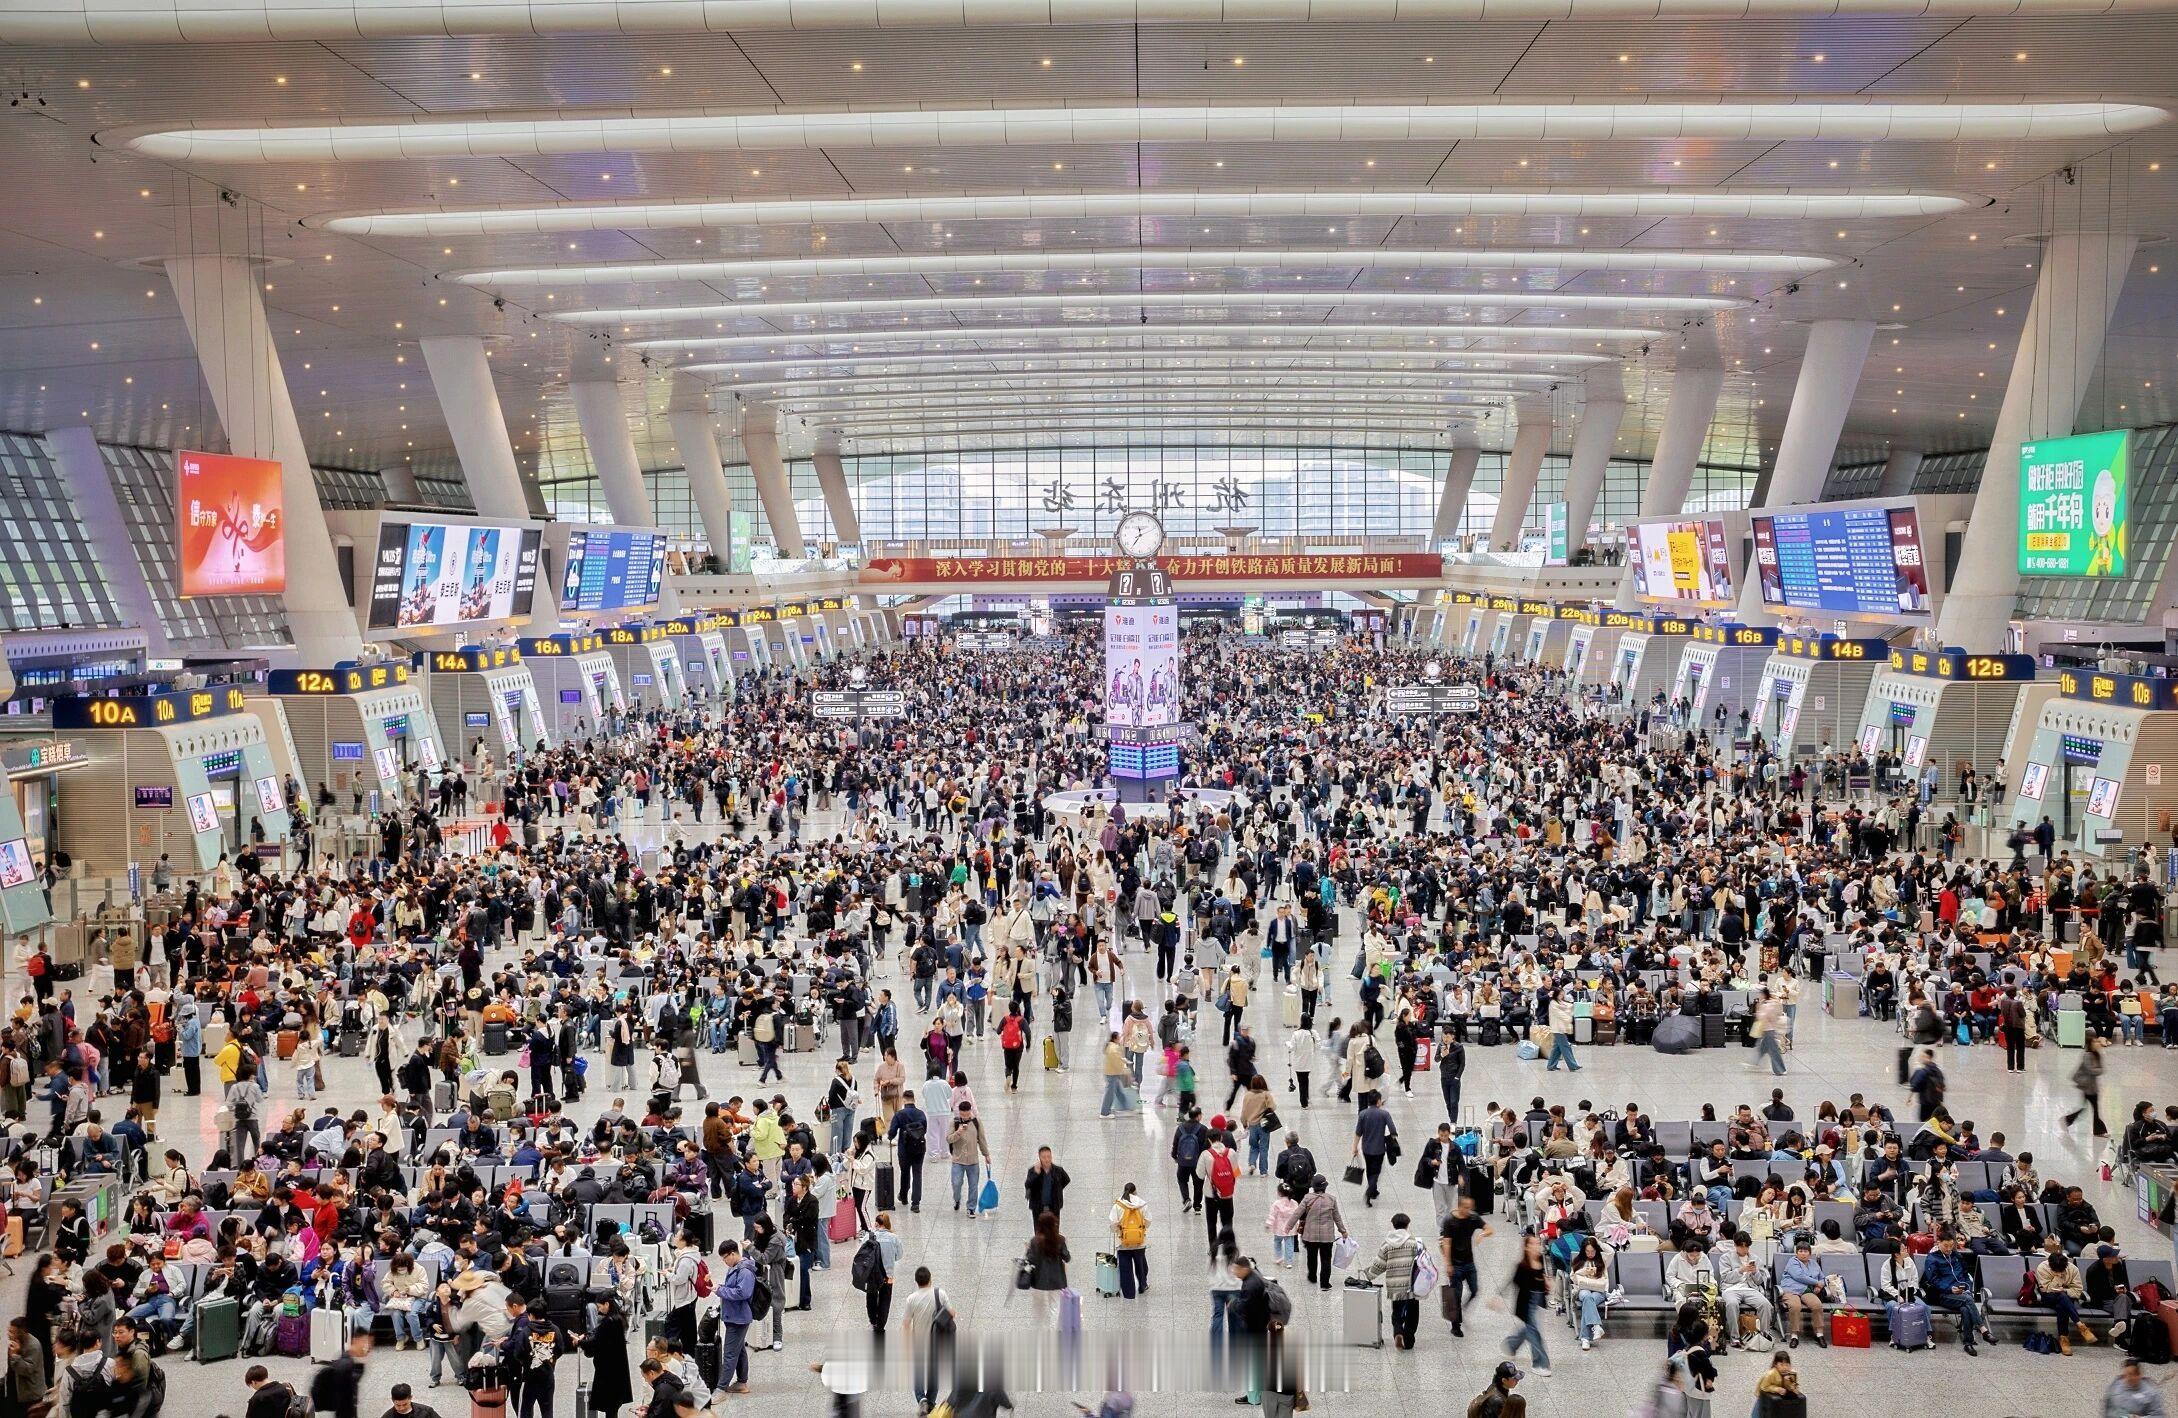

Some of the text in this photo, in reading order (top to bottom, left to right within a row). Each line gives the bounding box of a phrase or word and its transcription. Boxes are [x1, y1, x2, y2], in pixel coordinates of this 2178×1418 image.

[936, 559, 1132, 577] 深入学习贯彻党的二十大精
[667, 622, 689, 634] 20A
[1606, 614, 1629, 625] 20B
[1661, 621, 1687, 633] 18B
[610, 630, 634, 643] 18A
[1735, 629, 1763, 643] 16B
[535, 640, 562, 654] 16A
[1831, 641, 1863, 658] 14B
[436, 654, 468, 671] 14A
[1967, 658, 2006, 677] 12B
[297, 673, 335, 692] 12A
[2060, 672, 2077, 694] 11B
[228, 689, 244, 709] 11A
[2132, 682, 2151, 704] 10B
[90, 701, 136, 724] 10A
[156, 699, 175, 721] 10A
